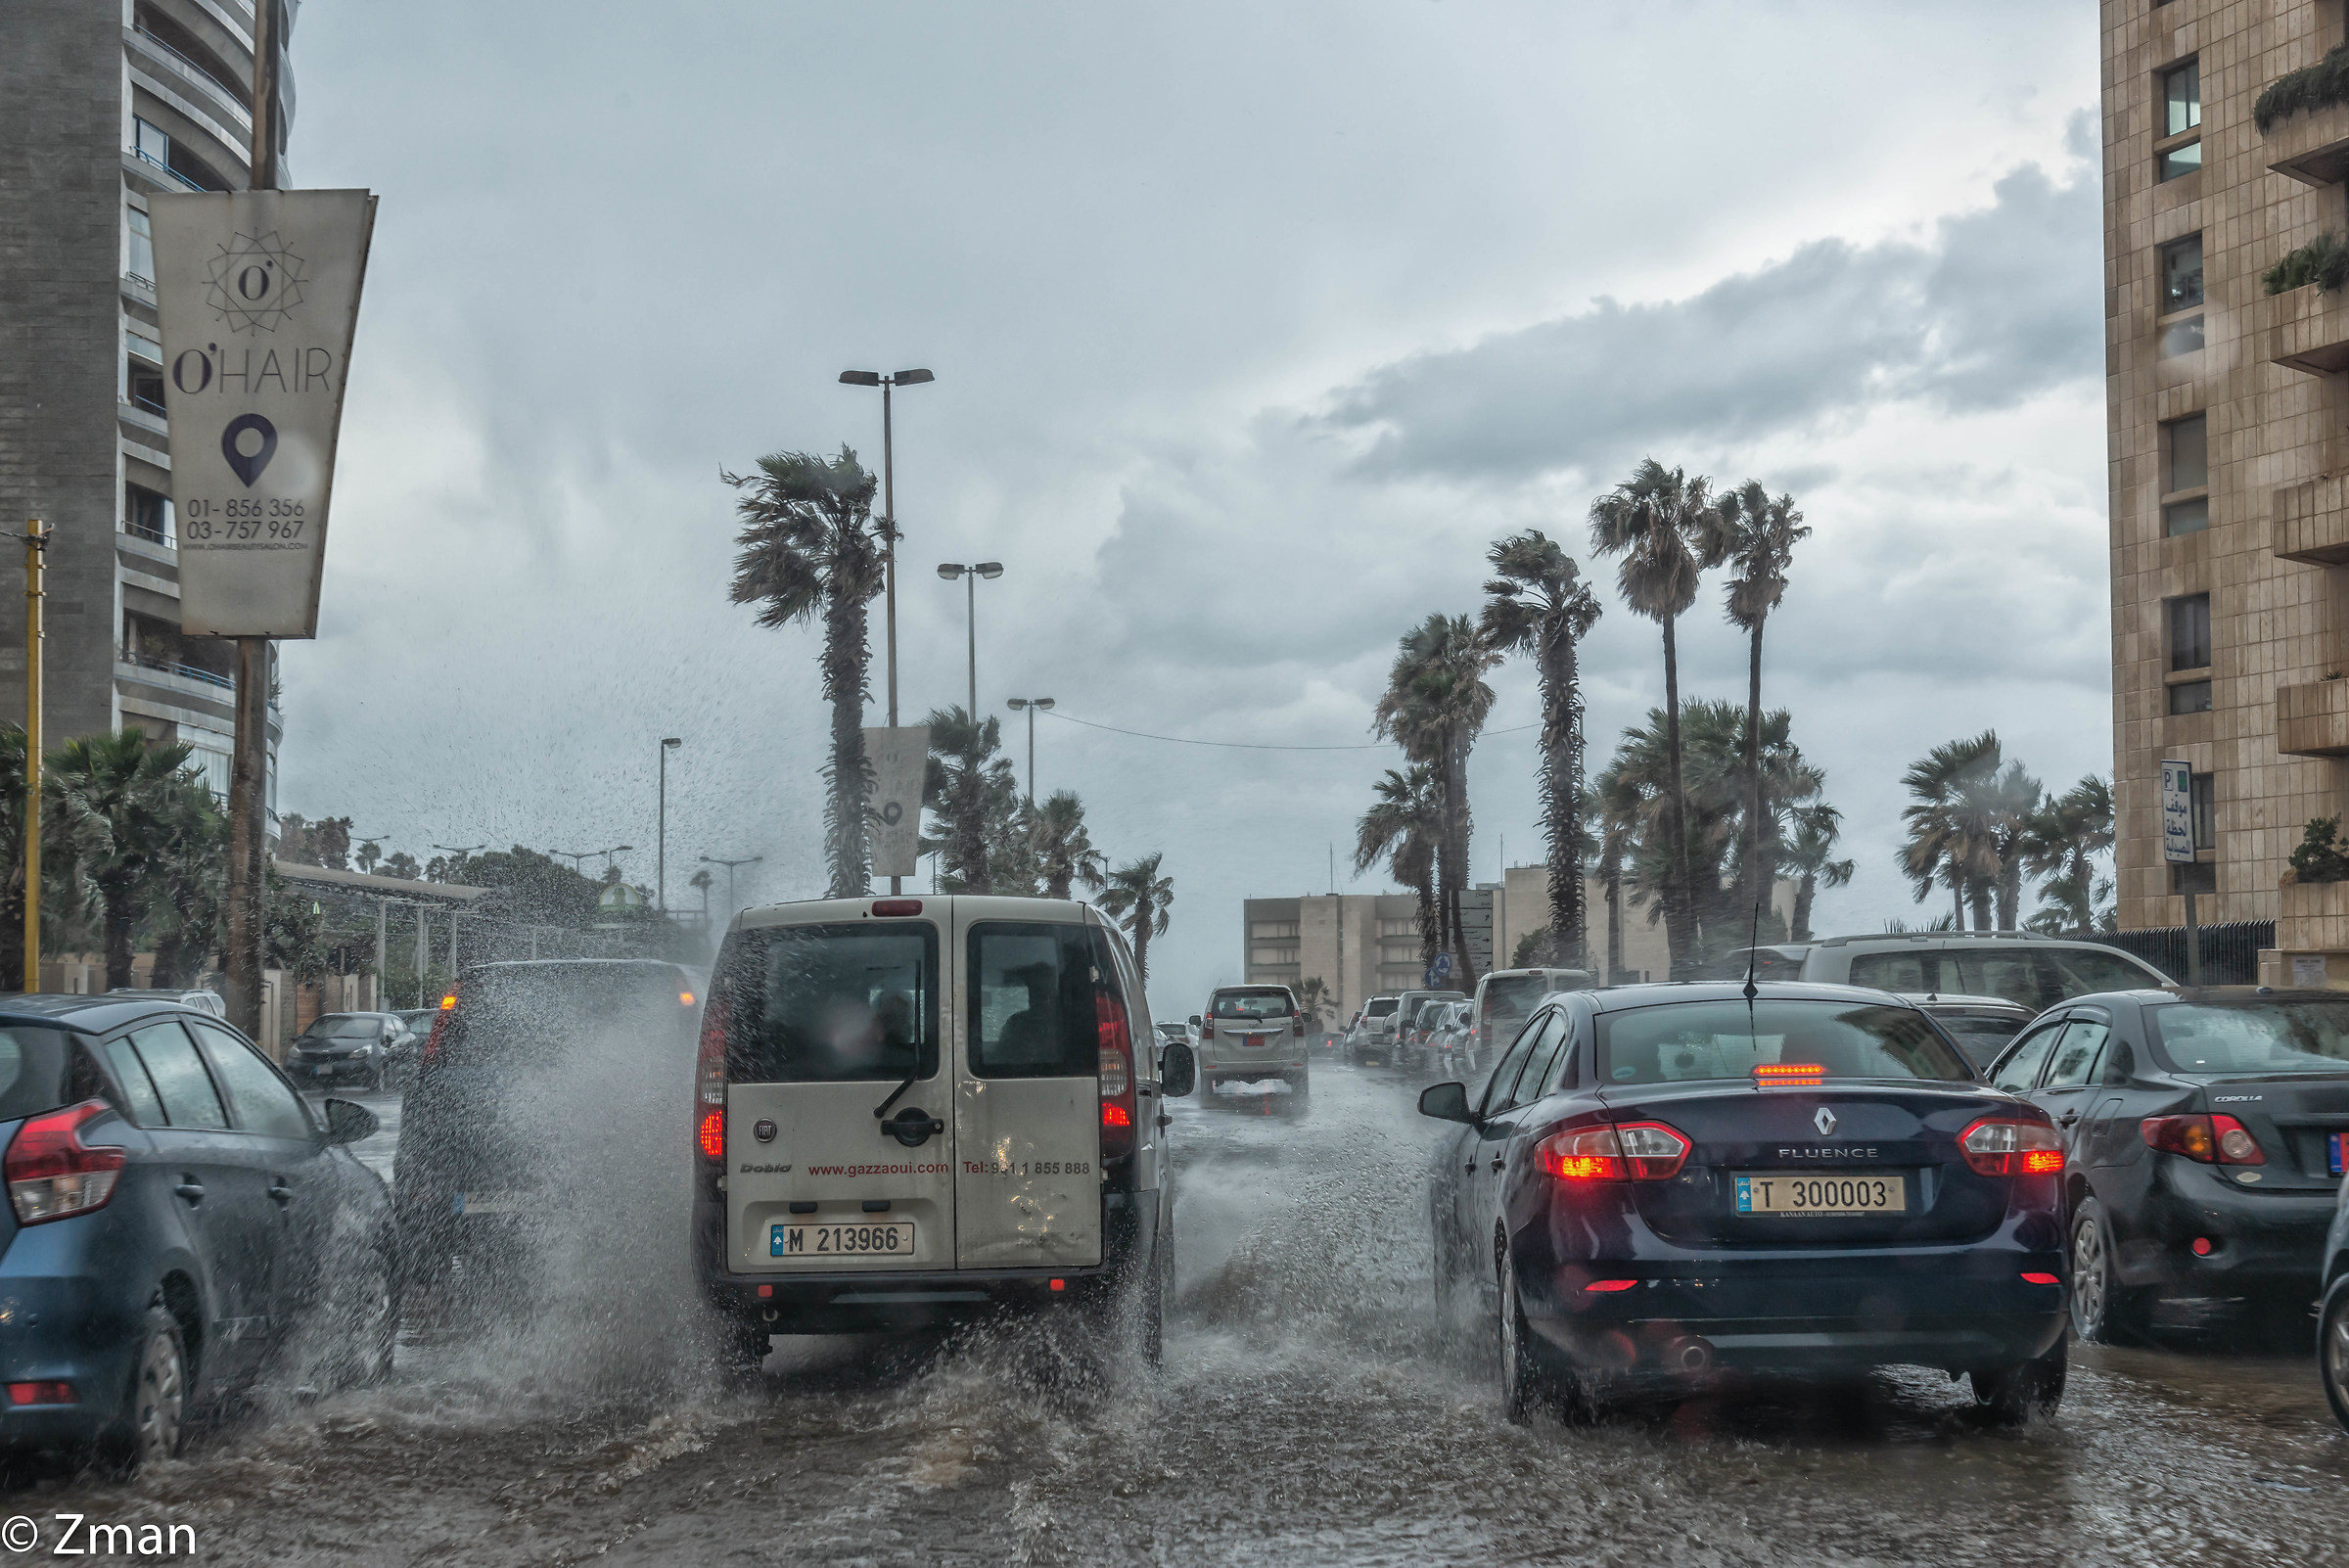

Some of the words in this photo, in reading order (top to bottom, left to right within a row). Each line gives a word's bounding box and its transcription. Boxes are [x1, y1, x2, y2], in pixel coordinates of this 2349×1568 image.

[172, 343, 332, 394] O'HAIR
[225, 498, 262, 517] 856
[268, 498, 305, 517] 356
[268, 520, 304, 538] 967
[2164, 771, 2171, 789] P
[2165, 794, 2188, 817] موقف
[2166, 819, 2188, 837] لحظة
[759, 1125, 772, 1136] FIAT
[1778, 1148, 1878, 1158] FLUENCE
[808, 1162, 949, 1177] www.gazzaoui.com
[963, 1161, 989, 1174] Tel:
[1022, 1162, 1029, 1175] 1
[1035, 1162, 1060, 1175] 855
[1065, 1162, 1090, 1175] 888
[1760, 1181, 1773, 1207] T
[1792, 1180, 1887, 1207] 300003
[789, 1228, 804, 1252] M
[817, 1226, 898, 1251] 213966
